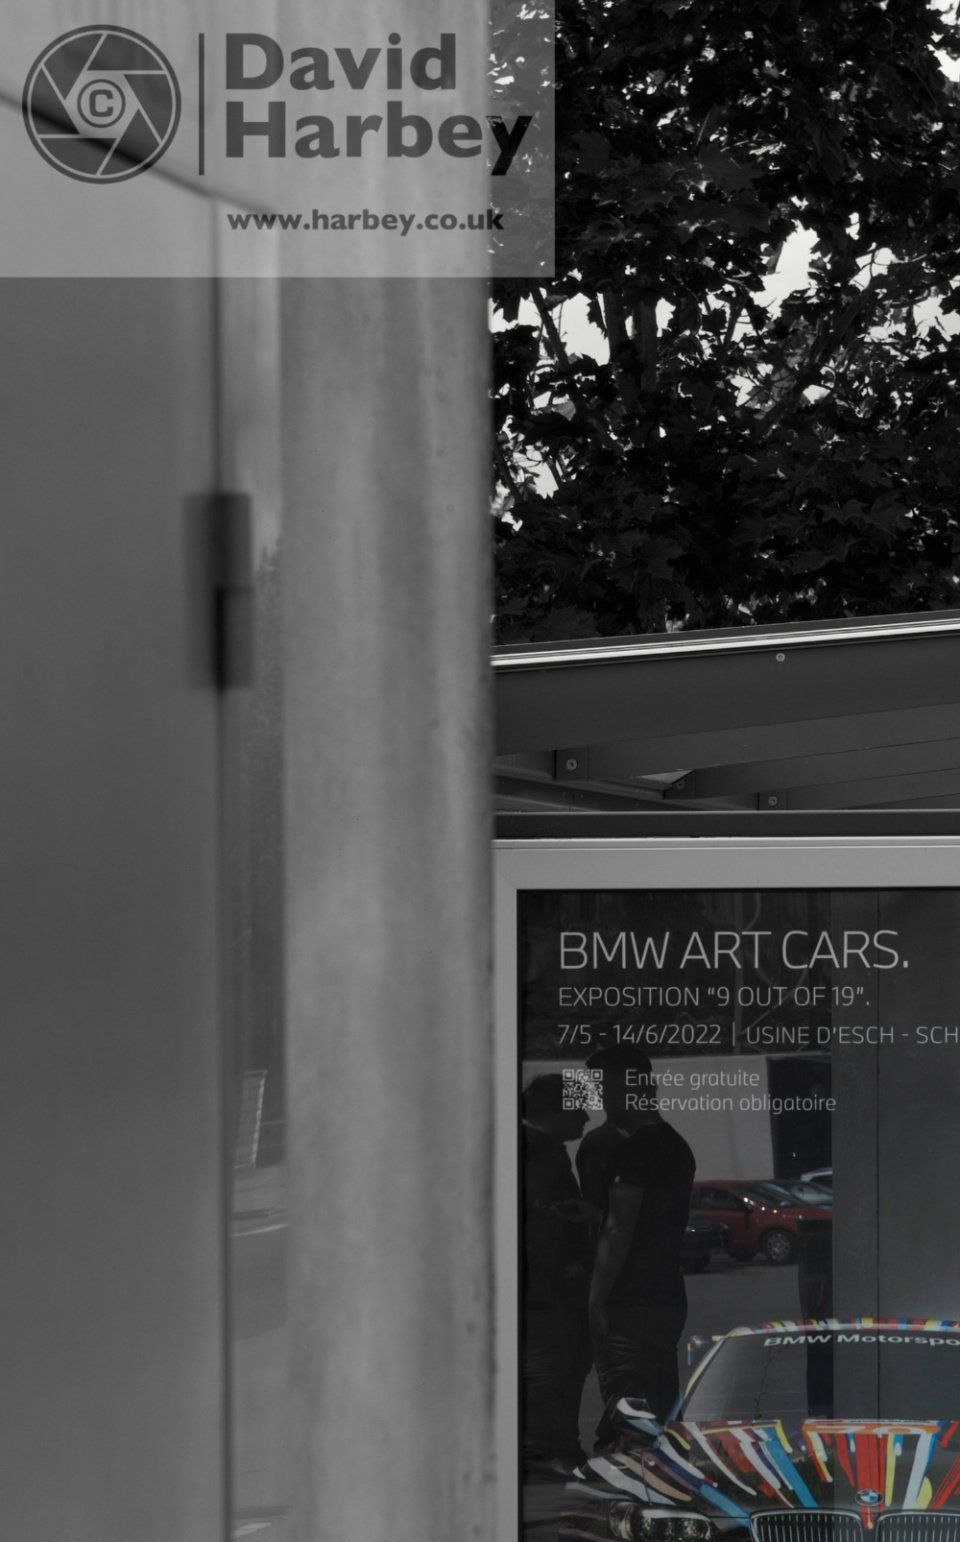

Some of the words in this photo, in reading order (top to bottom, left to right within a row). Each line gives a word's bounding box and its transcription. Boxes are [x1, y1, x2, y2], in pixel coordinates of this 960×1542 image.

[559, 931, 671, 970] BMW
[680, 930, 772, 969] ART
[781, 929, 910, 970] CARS.
[558, 986, 700, 1007] EXPOSITION
[738, 986, 788, 1007] OUT
[794, 986, 827, 1006] OF
[557, 1024, 592, 1045] 7/5
[612, 1024, 722, 1045] 14/6/2022
[746, 1026, 810, 1044] USINE
[817, 1025, 894, 1044] D'ESCH
[625, 1068, 686, 1087] Entrée
[690, 1069, 760, 1090] gratuite
[625, 1094, 736, 1112] Réservation
[739, 1093, 837, 1115] obligatoire
[763, 1334, 832, 1347] BMW
